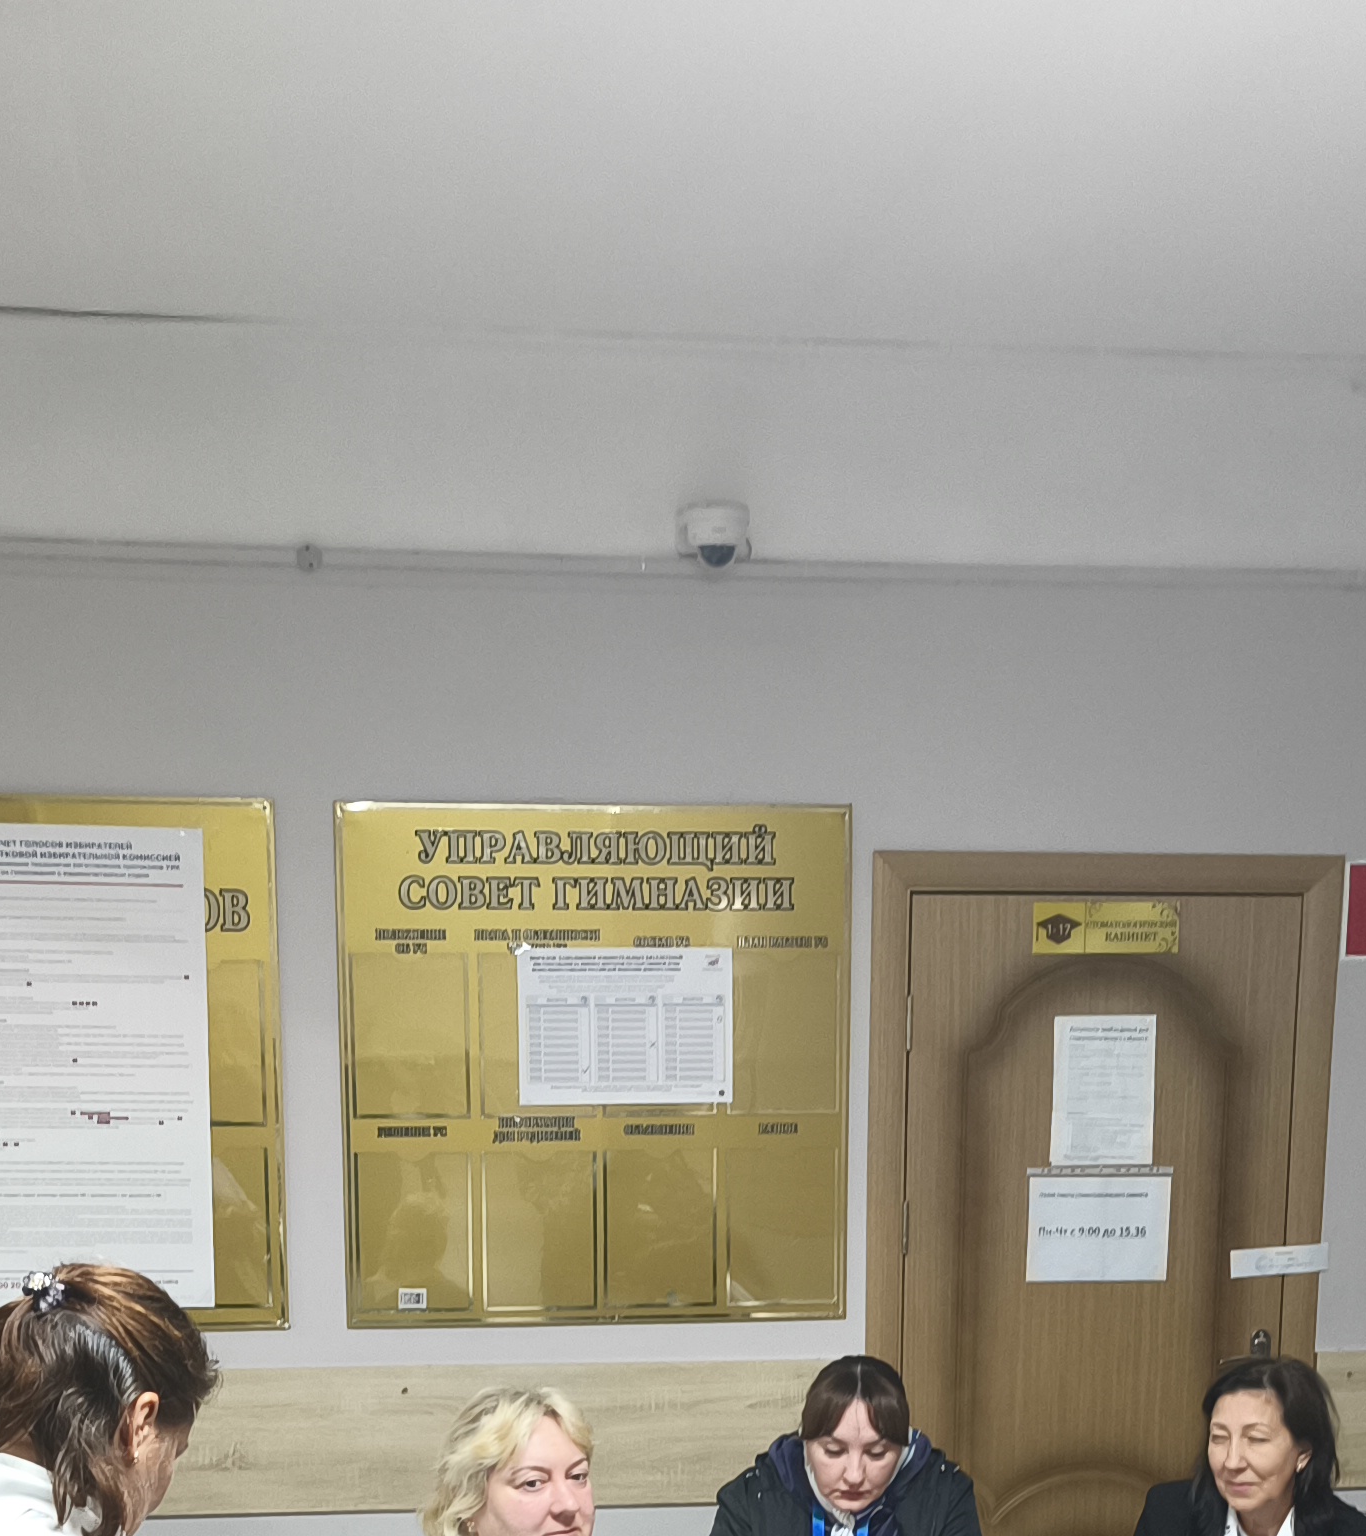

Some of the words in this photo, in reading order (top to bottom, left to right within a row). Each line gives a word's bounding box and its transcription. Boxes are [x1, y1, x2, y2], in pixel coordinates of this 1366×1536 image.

[415, 824, 777, 871] УПРАВЛЯЮЩИЙ
[398, 875, 540, 910] СОВЕТ
[552, 876, 796, 911] ГИМНАЗИИ
[1104, 931, 1158, 942] КАБИНЕТ
[1102, 1227, 1116, 1239] до
